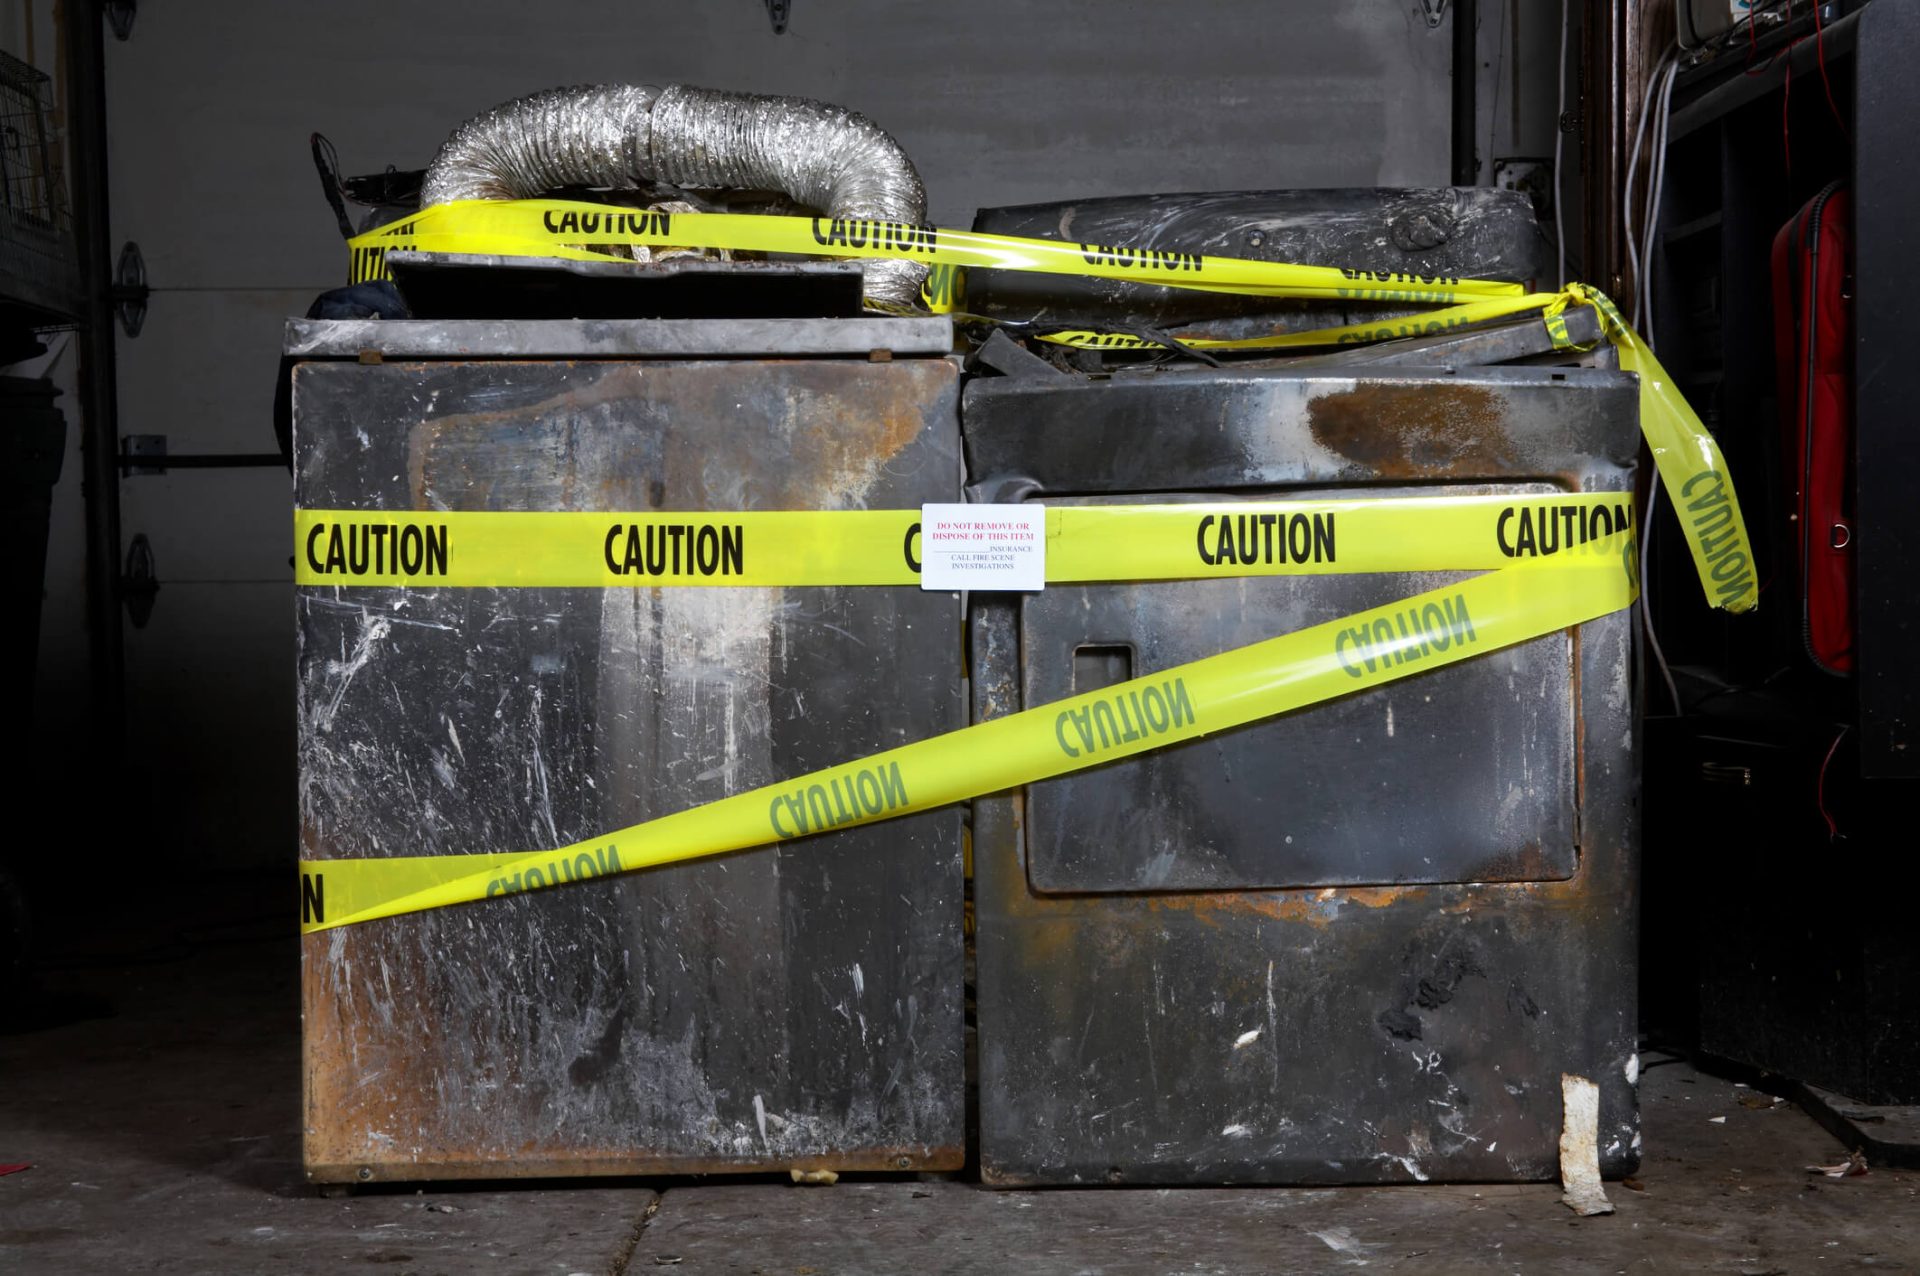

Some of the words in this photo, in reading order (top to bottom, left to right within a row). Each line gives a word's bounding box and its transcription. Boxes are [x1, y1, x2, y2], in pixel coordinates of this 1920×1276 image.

[812, 216, 938, 253] CAUTION
[307, 523, 448, 576] CAUTION
[604, 524, 743, 576] CAUTION
[1197, 513, 1336, 565] CAUTION
[937, 522, 950, 530] DO
[953, 522, 972, 530] NOT
[974, 522, 1014, 530] REMOVE
[1016, 522, 1029, 530] OR
